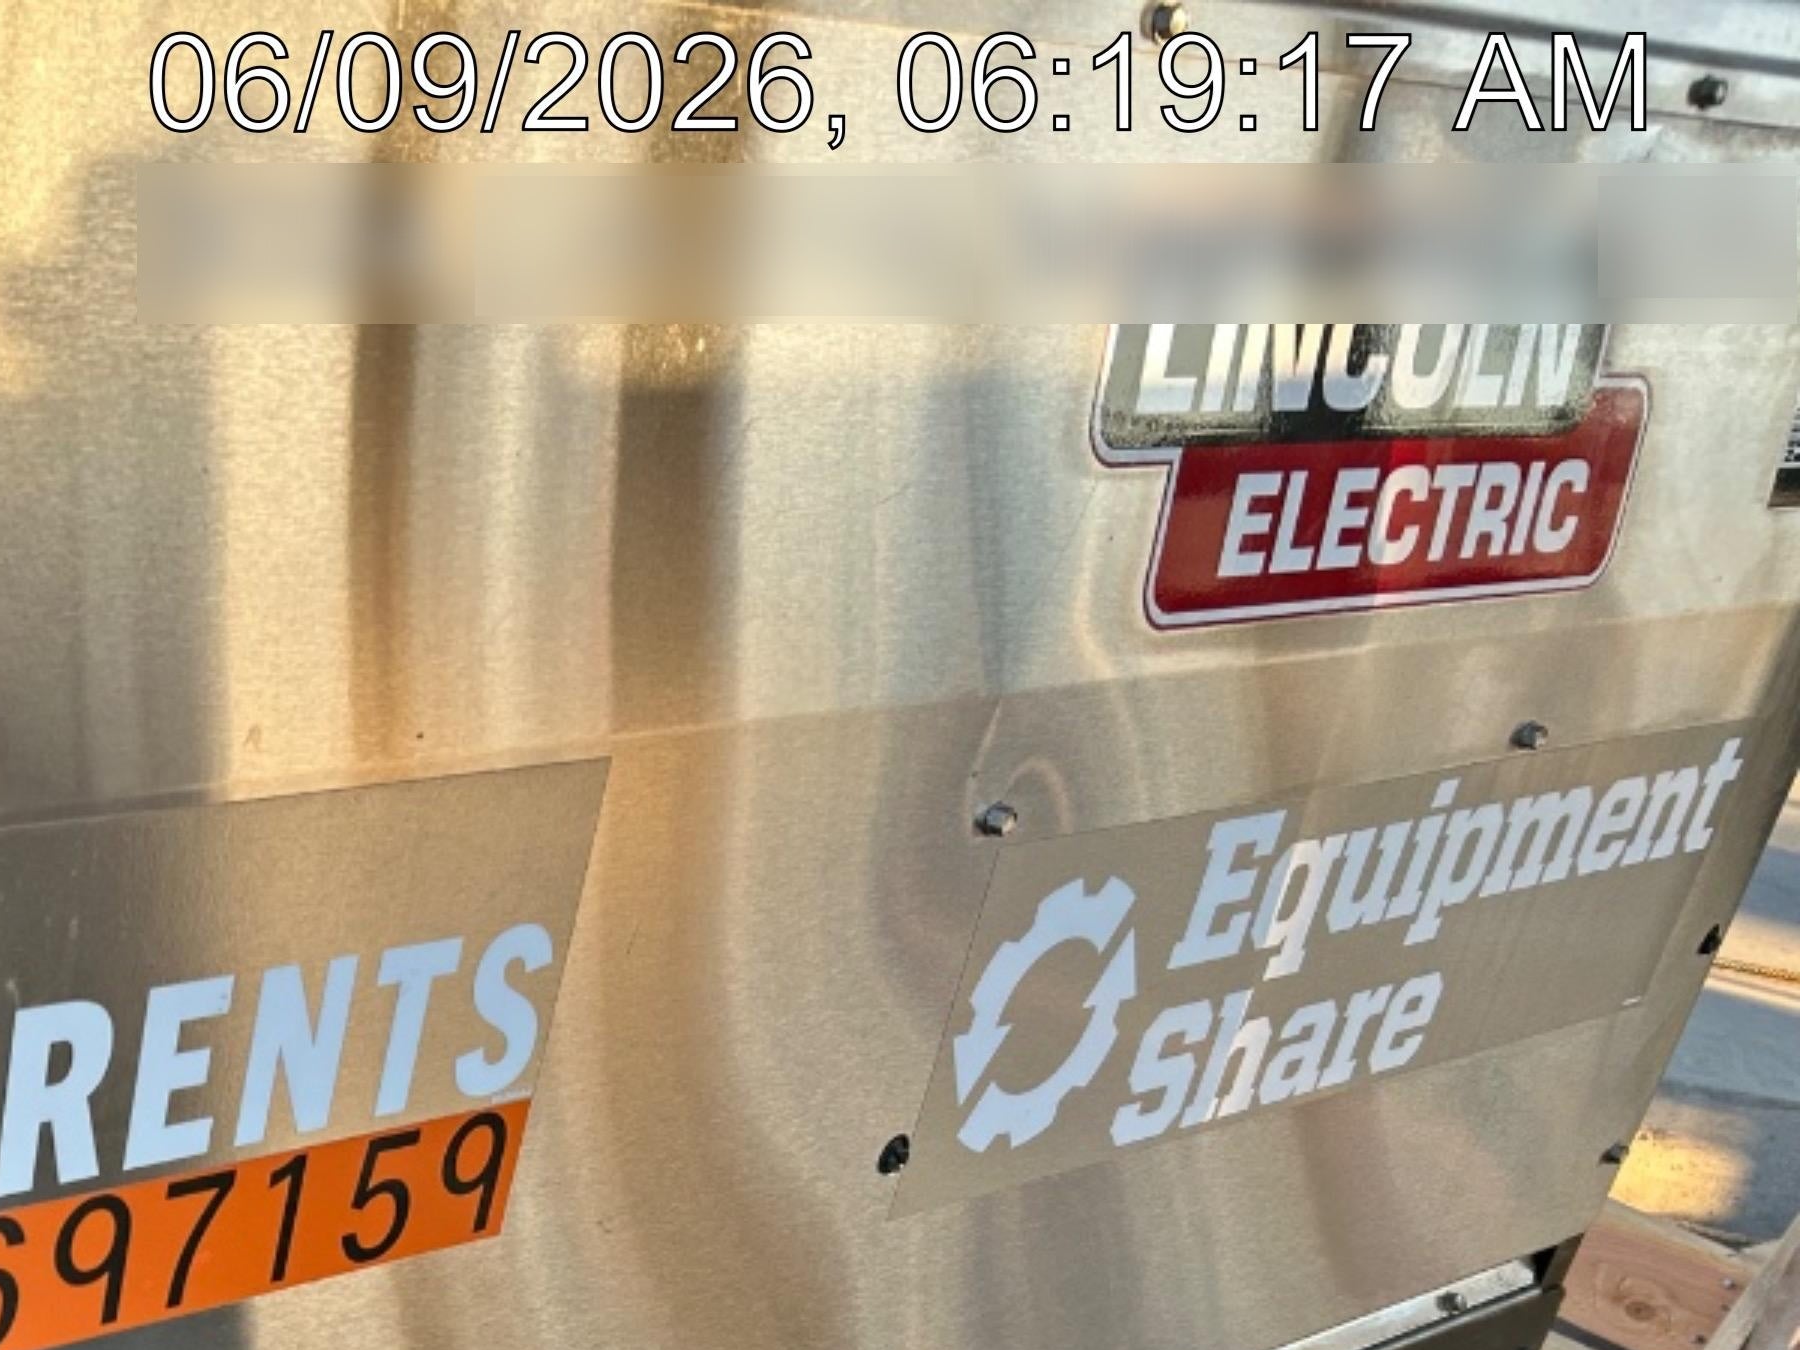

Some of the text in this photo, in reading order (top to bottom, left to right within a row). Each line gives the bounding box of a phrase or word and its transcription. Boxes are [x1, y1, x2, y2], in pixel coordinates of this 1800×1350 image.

[1217, 458, 1589, 579] ELECTRIC
[1167, 737, 1744, 981] Equipment
[1108, 971, 1443, 1148] Share
